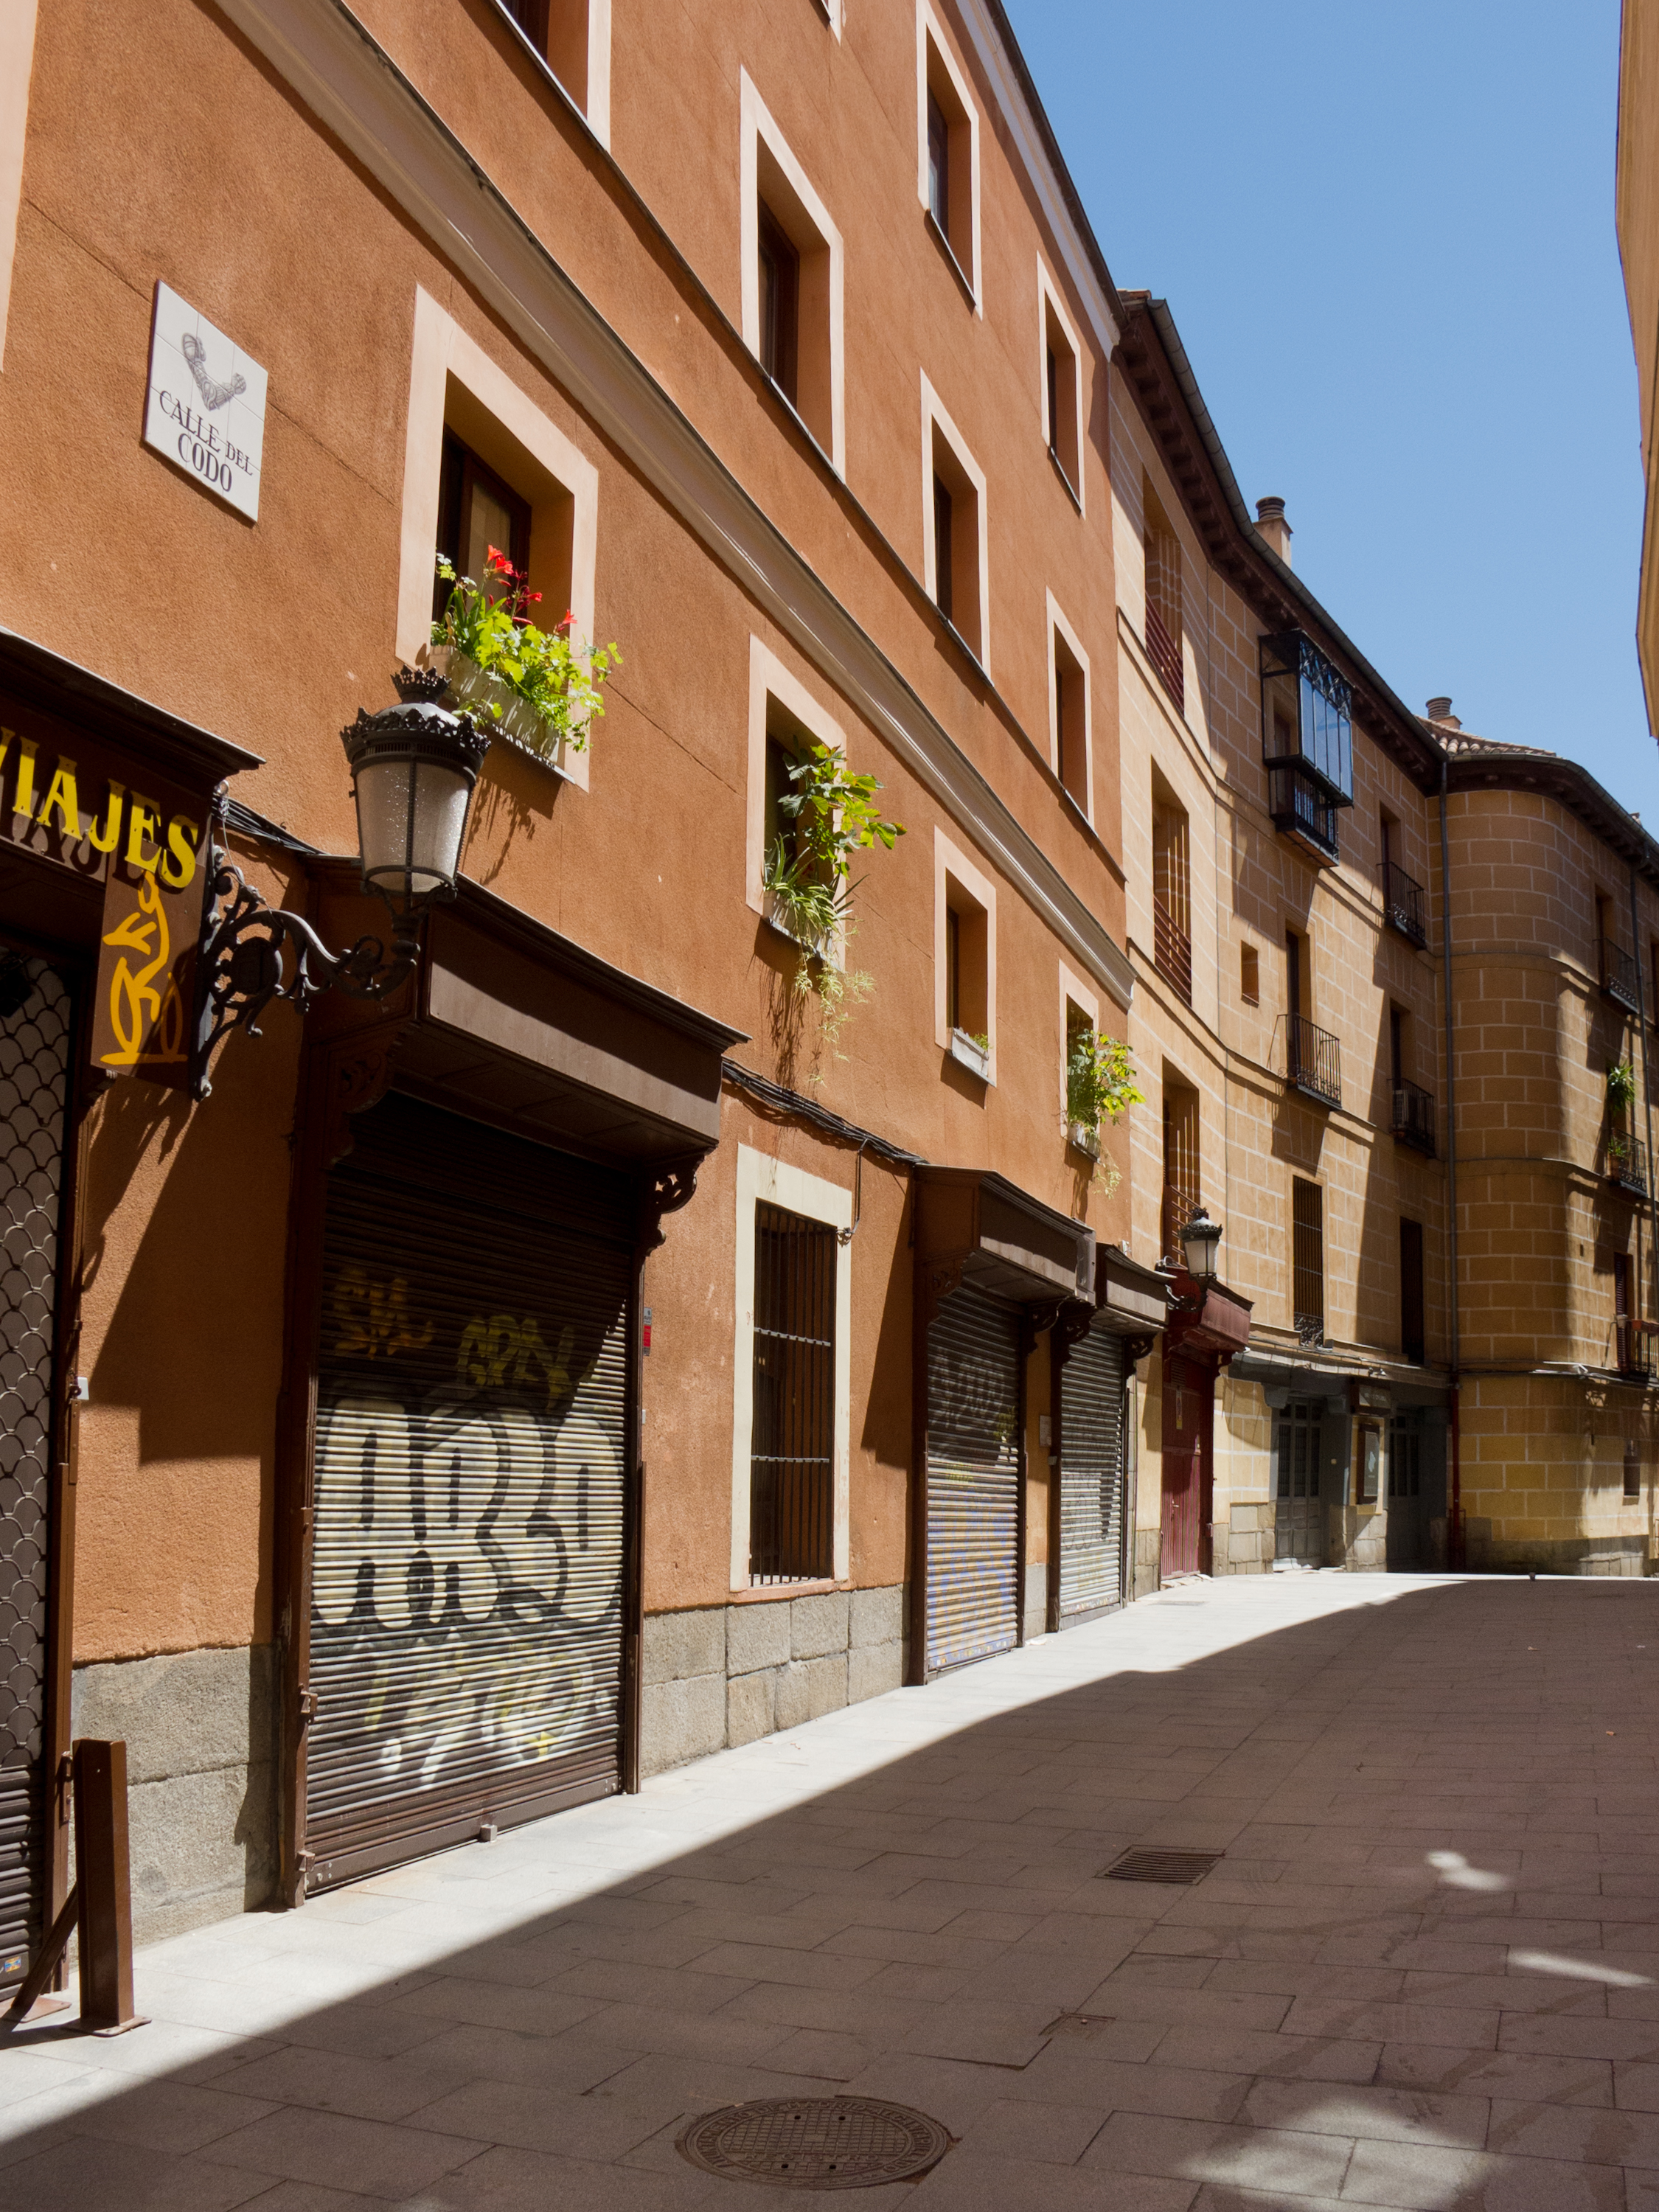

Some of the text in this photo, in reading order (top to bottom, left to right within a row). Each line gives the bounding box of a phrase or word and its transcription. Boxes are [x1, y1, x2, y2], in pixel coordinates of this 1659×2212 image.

[159, 391, 253, 476] CALLE DEL
[178, 433, 232, 492] CODO
[744, 2153, 879, 2161] REGISTRO
